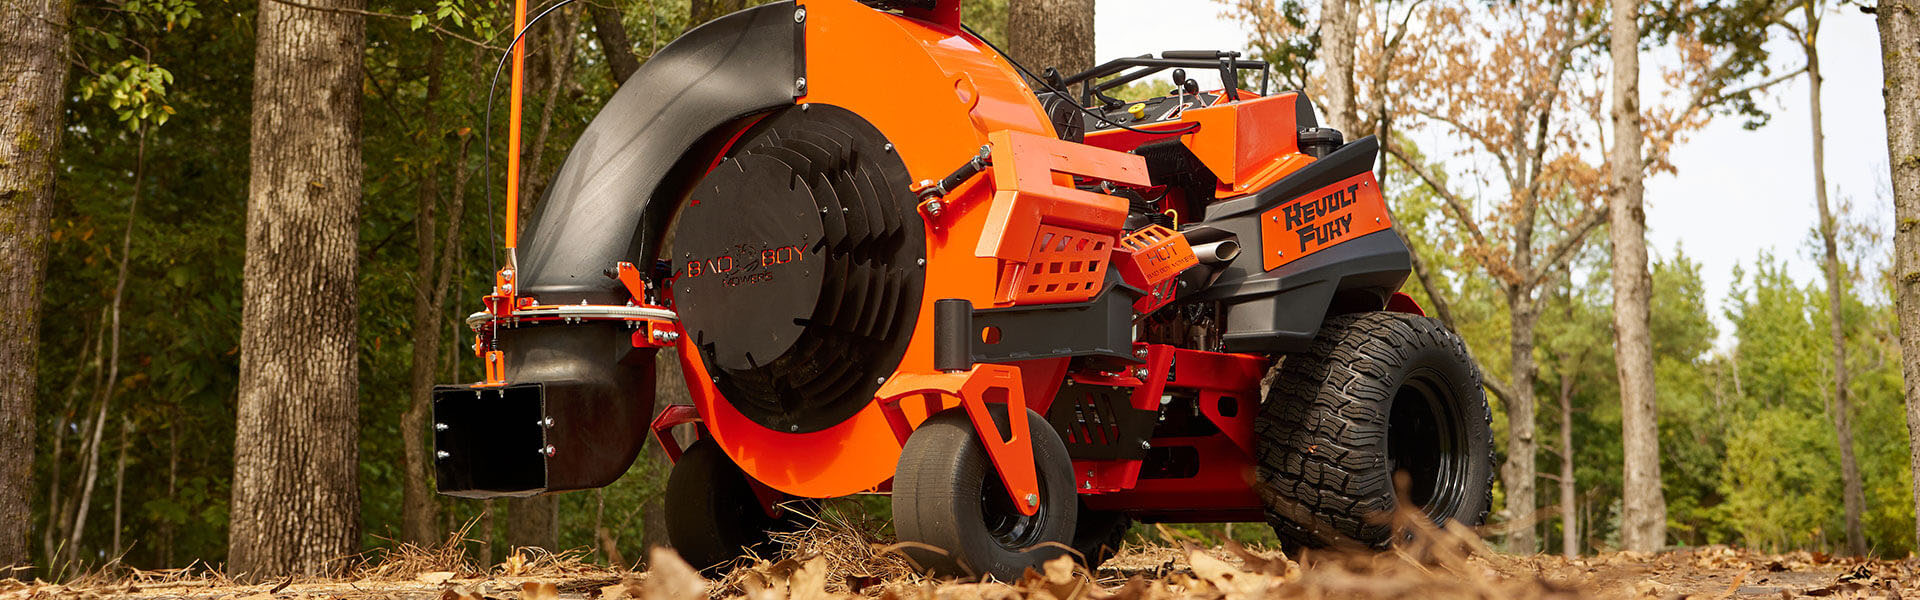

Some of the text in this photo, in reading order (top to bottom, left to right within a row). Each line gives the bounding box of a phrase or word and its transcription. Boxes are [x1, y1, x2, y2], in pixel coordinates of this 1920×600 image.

[687, 243, 808, 278] BAD BOY
[1146, 242, 1177, 266] HOT
[721, 272, 774, 287] MOWERS
